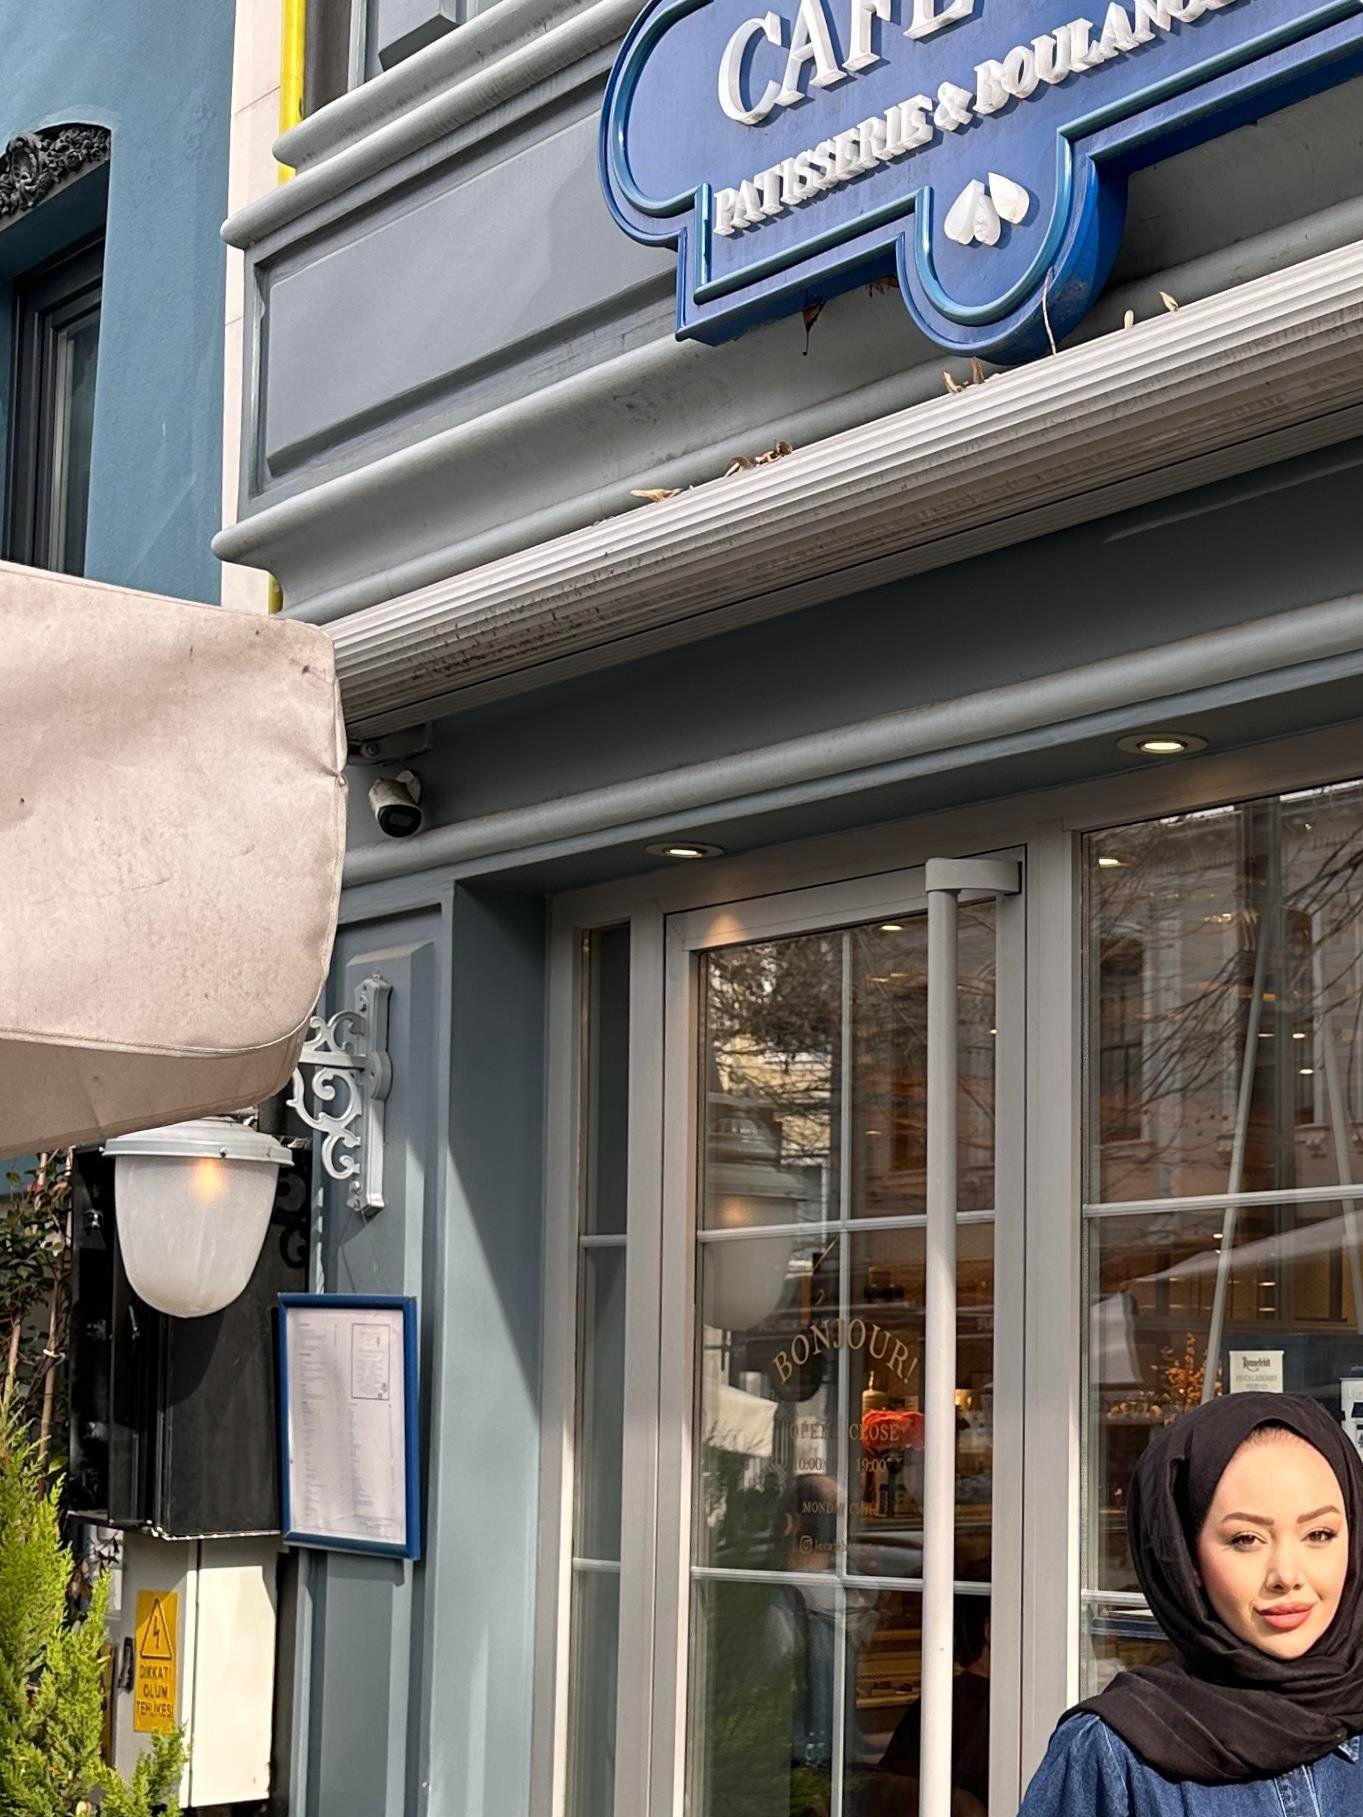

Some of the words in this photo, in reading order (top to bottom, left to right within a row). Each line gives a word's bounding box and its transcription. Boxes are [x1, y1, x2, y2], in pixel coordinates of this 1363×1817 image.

[714, 94, 933, 236] PATISSERIE
[934, 82, 973, 132] &
[972, 0, 1237, 115] BOULAN
[773, 1318, 918, 1385] BONJOUR!
